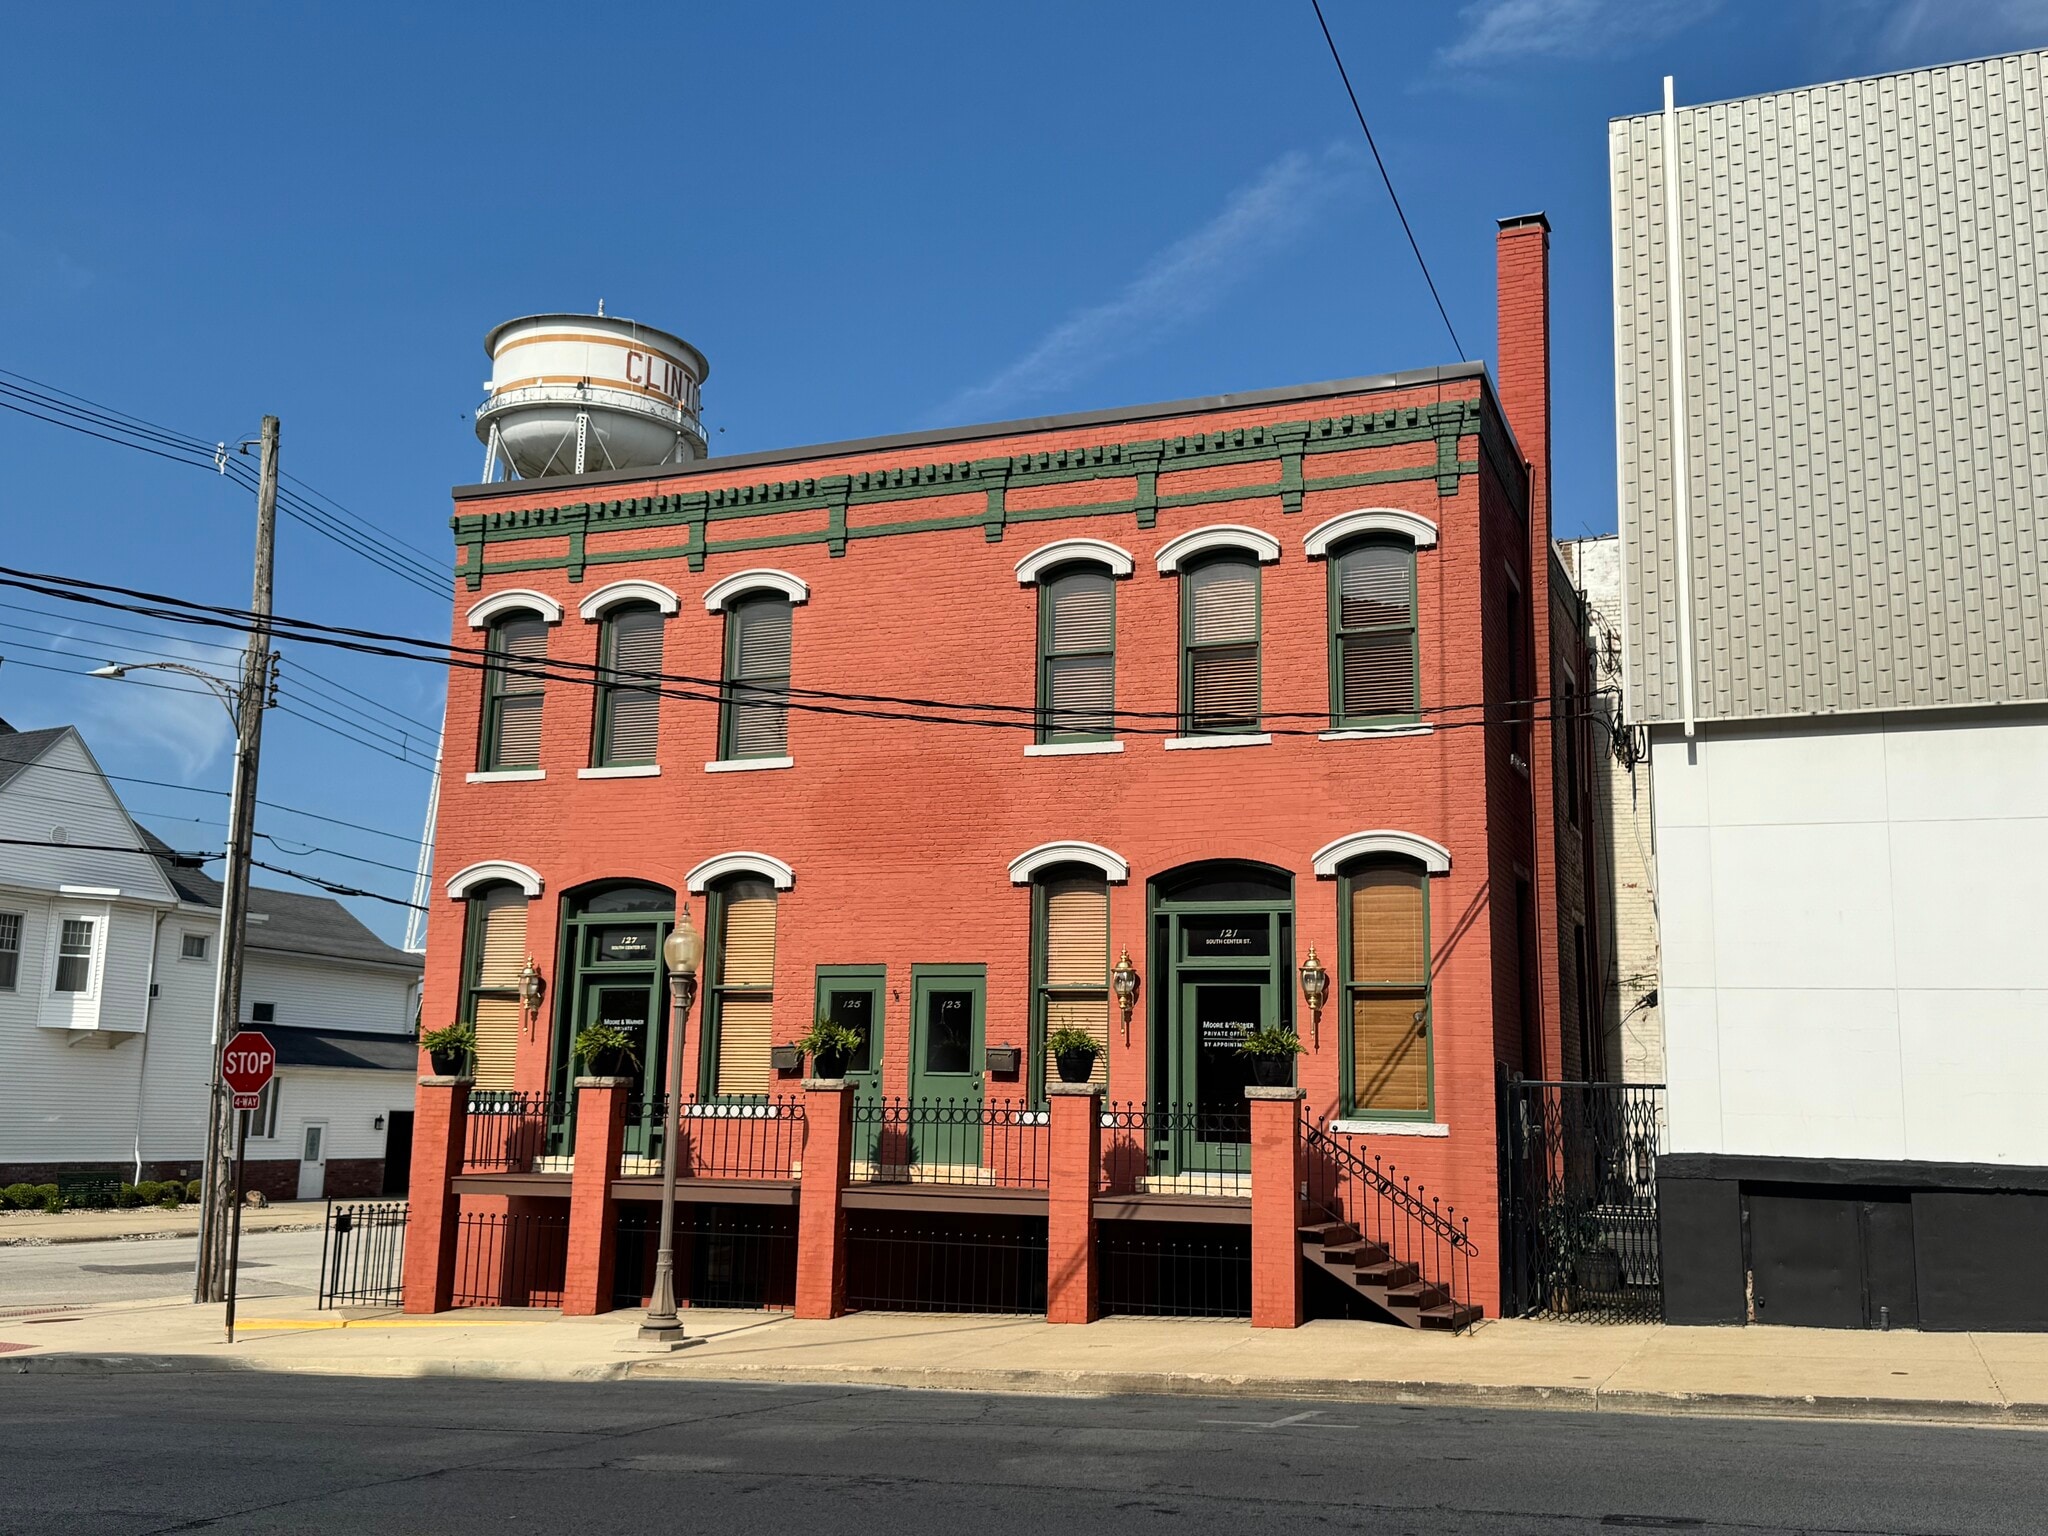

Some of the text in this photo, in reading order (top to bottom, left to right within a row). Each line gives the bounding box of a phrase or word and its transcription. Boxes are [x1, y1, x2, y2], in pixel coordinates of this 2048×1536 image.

[1220, 929, 1238, 938] 121
[621, 936, 638, 945] 127
[843, 1001, 862, 1009] 125
[943, 1000, 962, 1009] 123
[1230, 1021, 1254, 1029] WNER
[225, 1051, 271, 1075] STOP
[234, 1097, 258, 1107] 4-WAY
